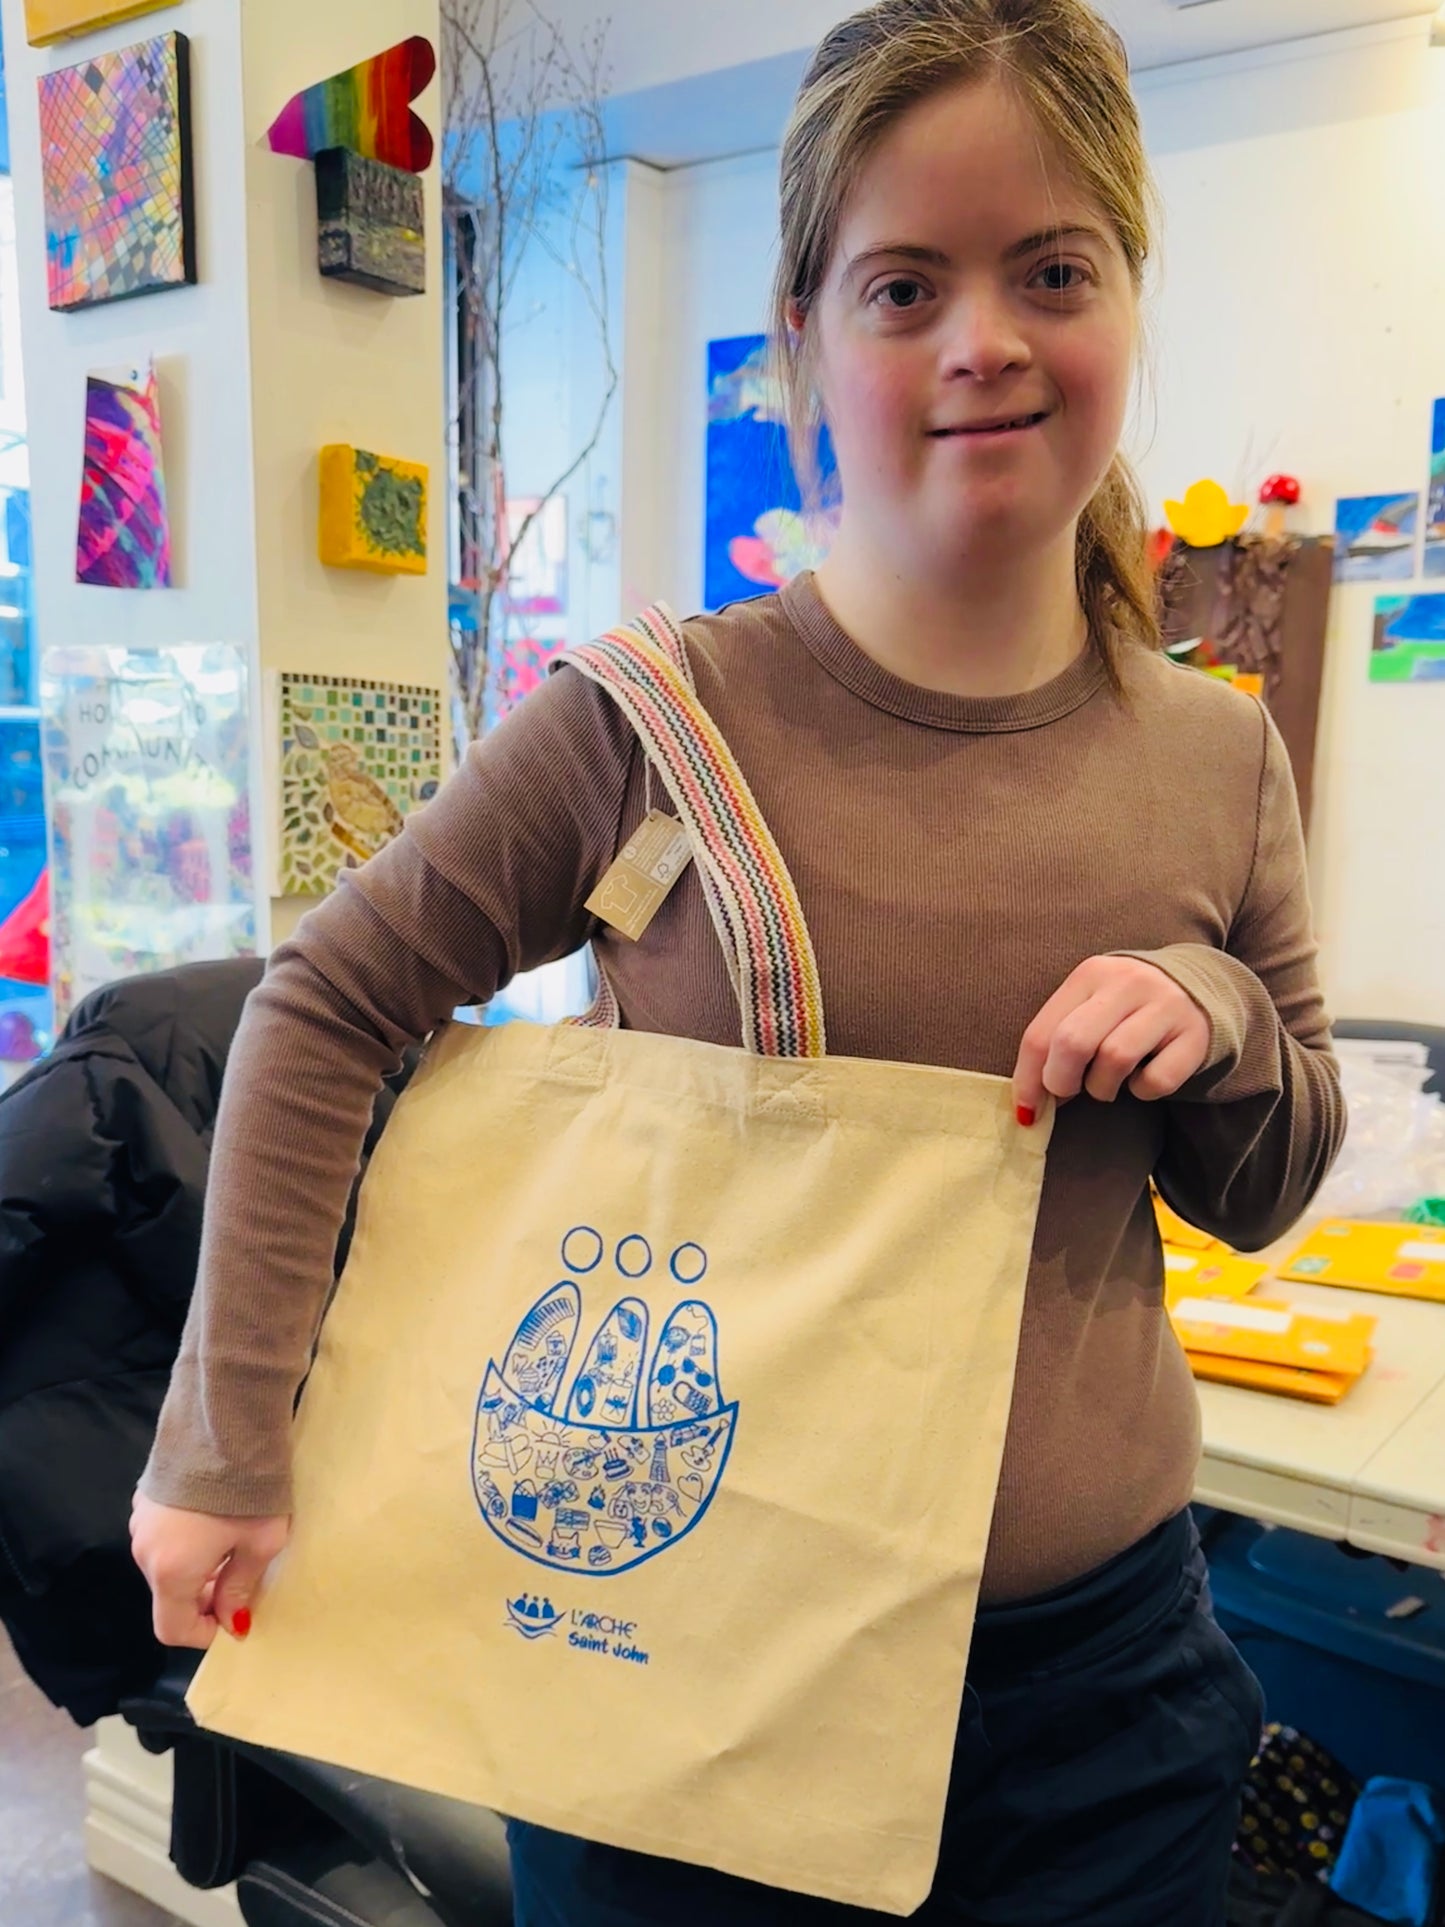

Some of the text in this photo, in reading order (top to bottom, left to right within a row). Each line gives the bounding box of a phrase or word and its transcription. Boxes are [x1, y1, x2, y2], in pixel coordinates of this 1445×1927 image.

[571, 1608, 636, 1639] L'ARCHE
[568, 1631, 648, 1665] Saint John
